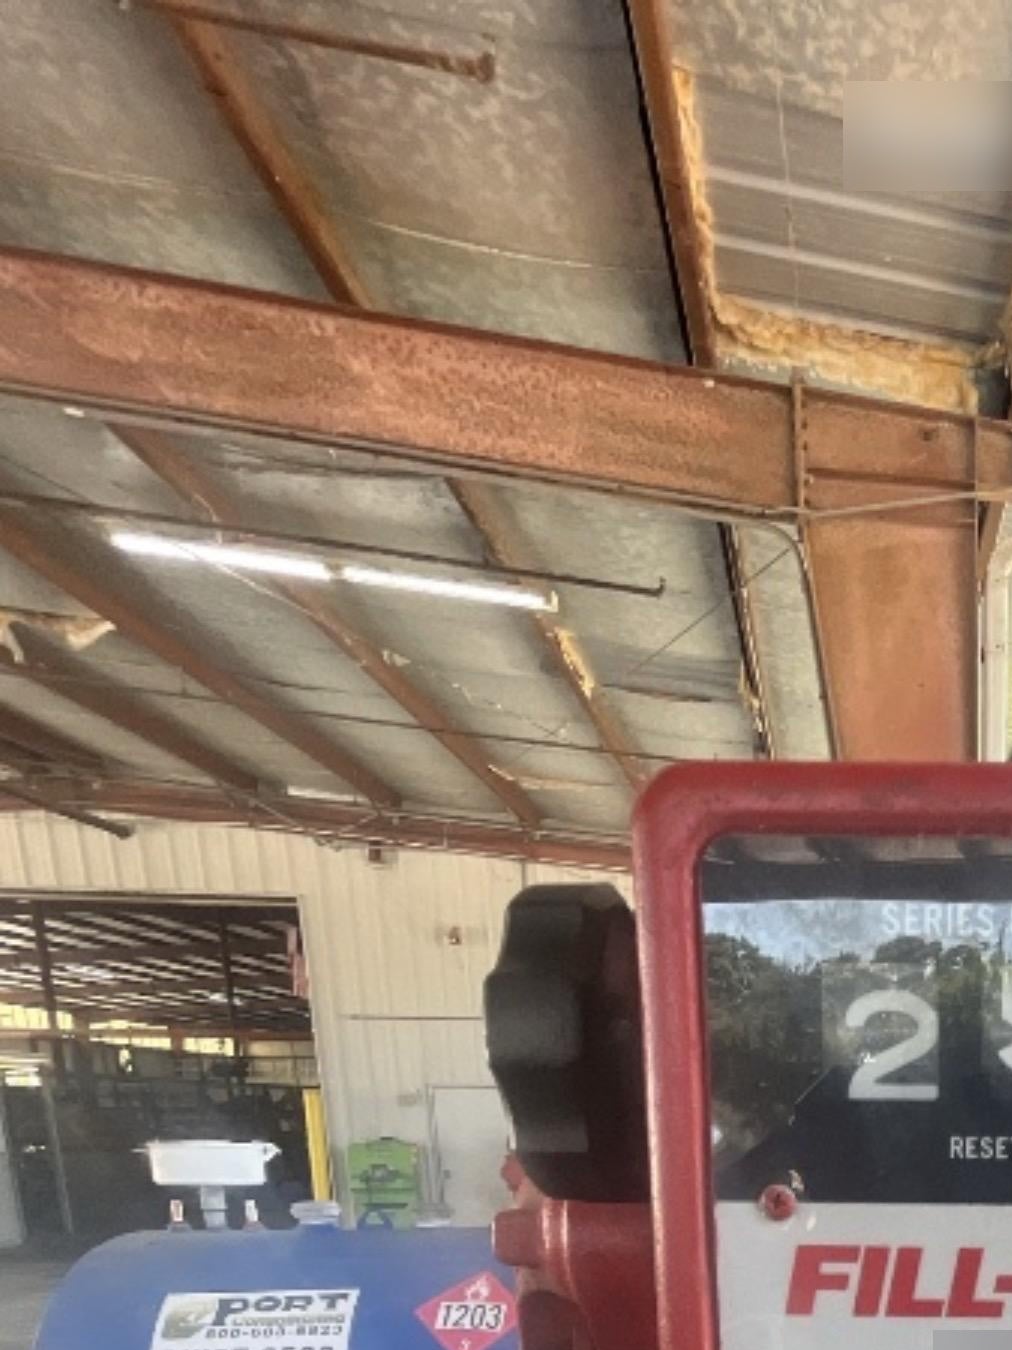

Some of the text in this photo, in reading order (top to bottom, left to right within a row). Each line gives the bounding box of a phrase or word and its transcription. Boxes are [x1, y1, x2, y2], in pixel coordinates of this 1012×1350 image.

[881, 903, 995, 938] SERIES
[212, 1292, 350, 1326] PORT
[442, 1304, 502, 1329] 1203
